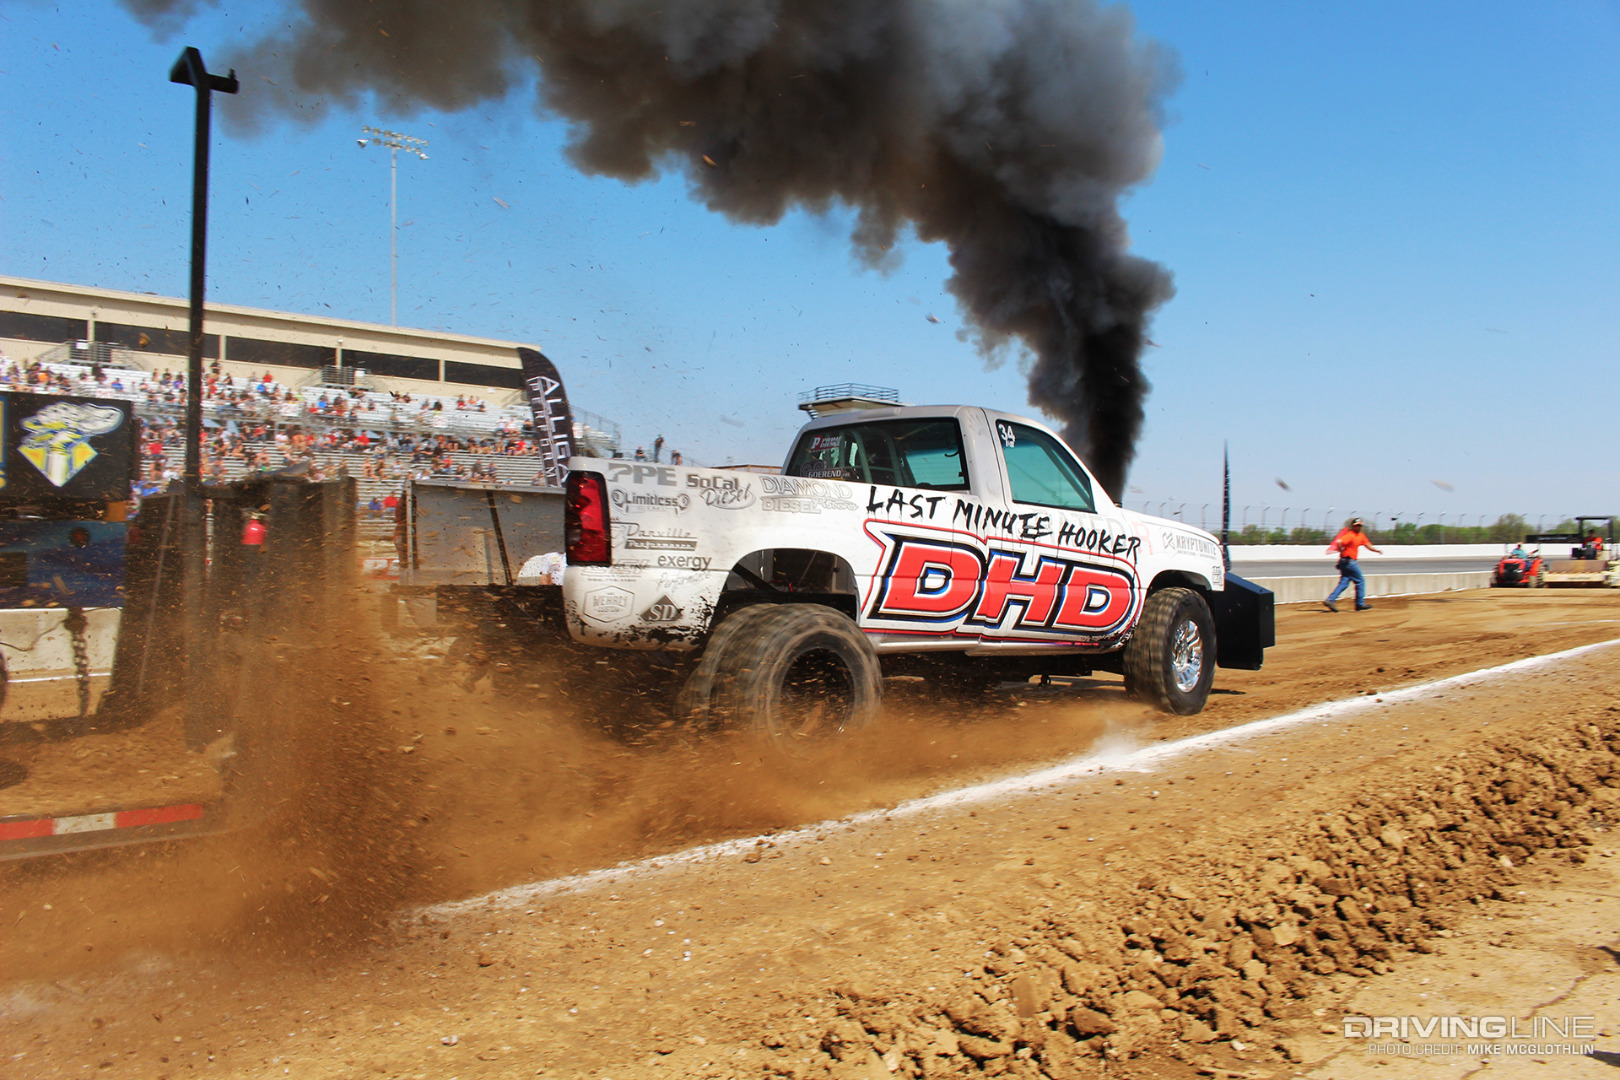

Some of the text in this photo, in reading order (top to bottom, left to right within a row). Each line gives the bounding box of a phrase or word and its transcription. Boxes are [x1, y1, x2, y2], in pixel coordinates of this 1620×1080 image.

[998, 424, 1016, 442] 34
[686, 473, 740, 490] SoCal
[759, 475, 853, 499] DIAMOND
[625, 492, 679, 507] Limitless
[762, 498, 822, 514] DIESEL
[865, 485, 1141, 563] LAST MINUTE HOOKER
[657, 554, 712, 571] exergy
[868, 531, 1135, 634] DHD
[648, 603, 677, 621] SD
